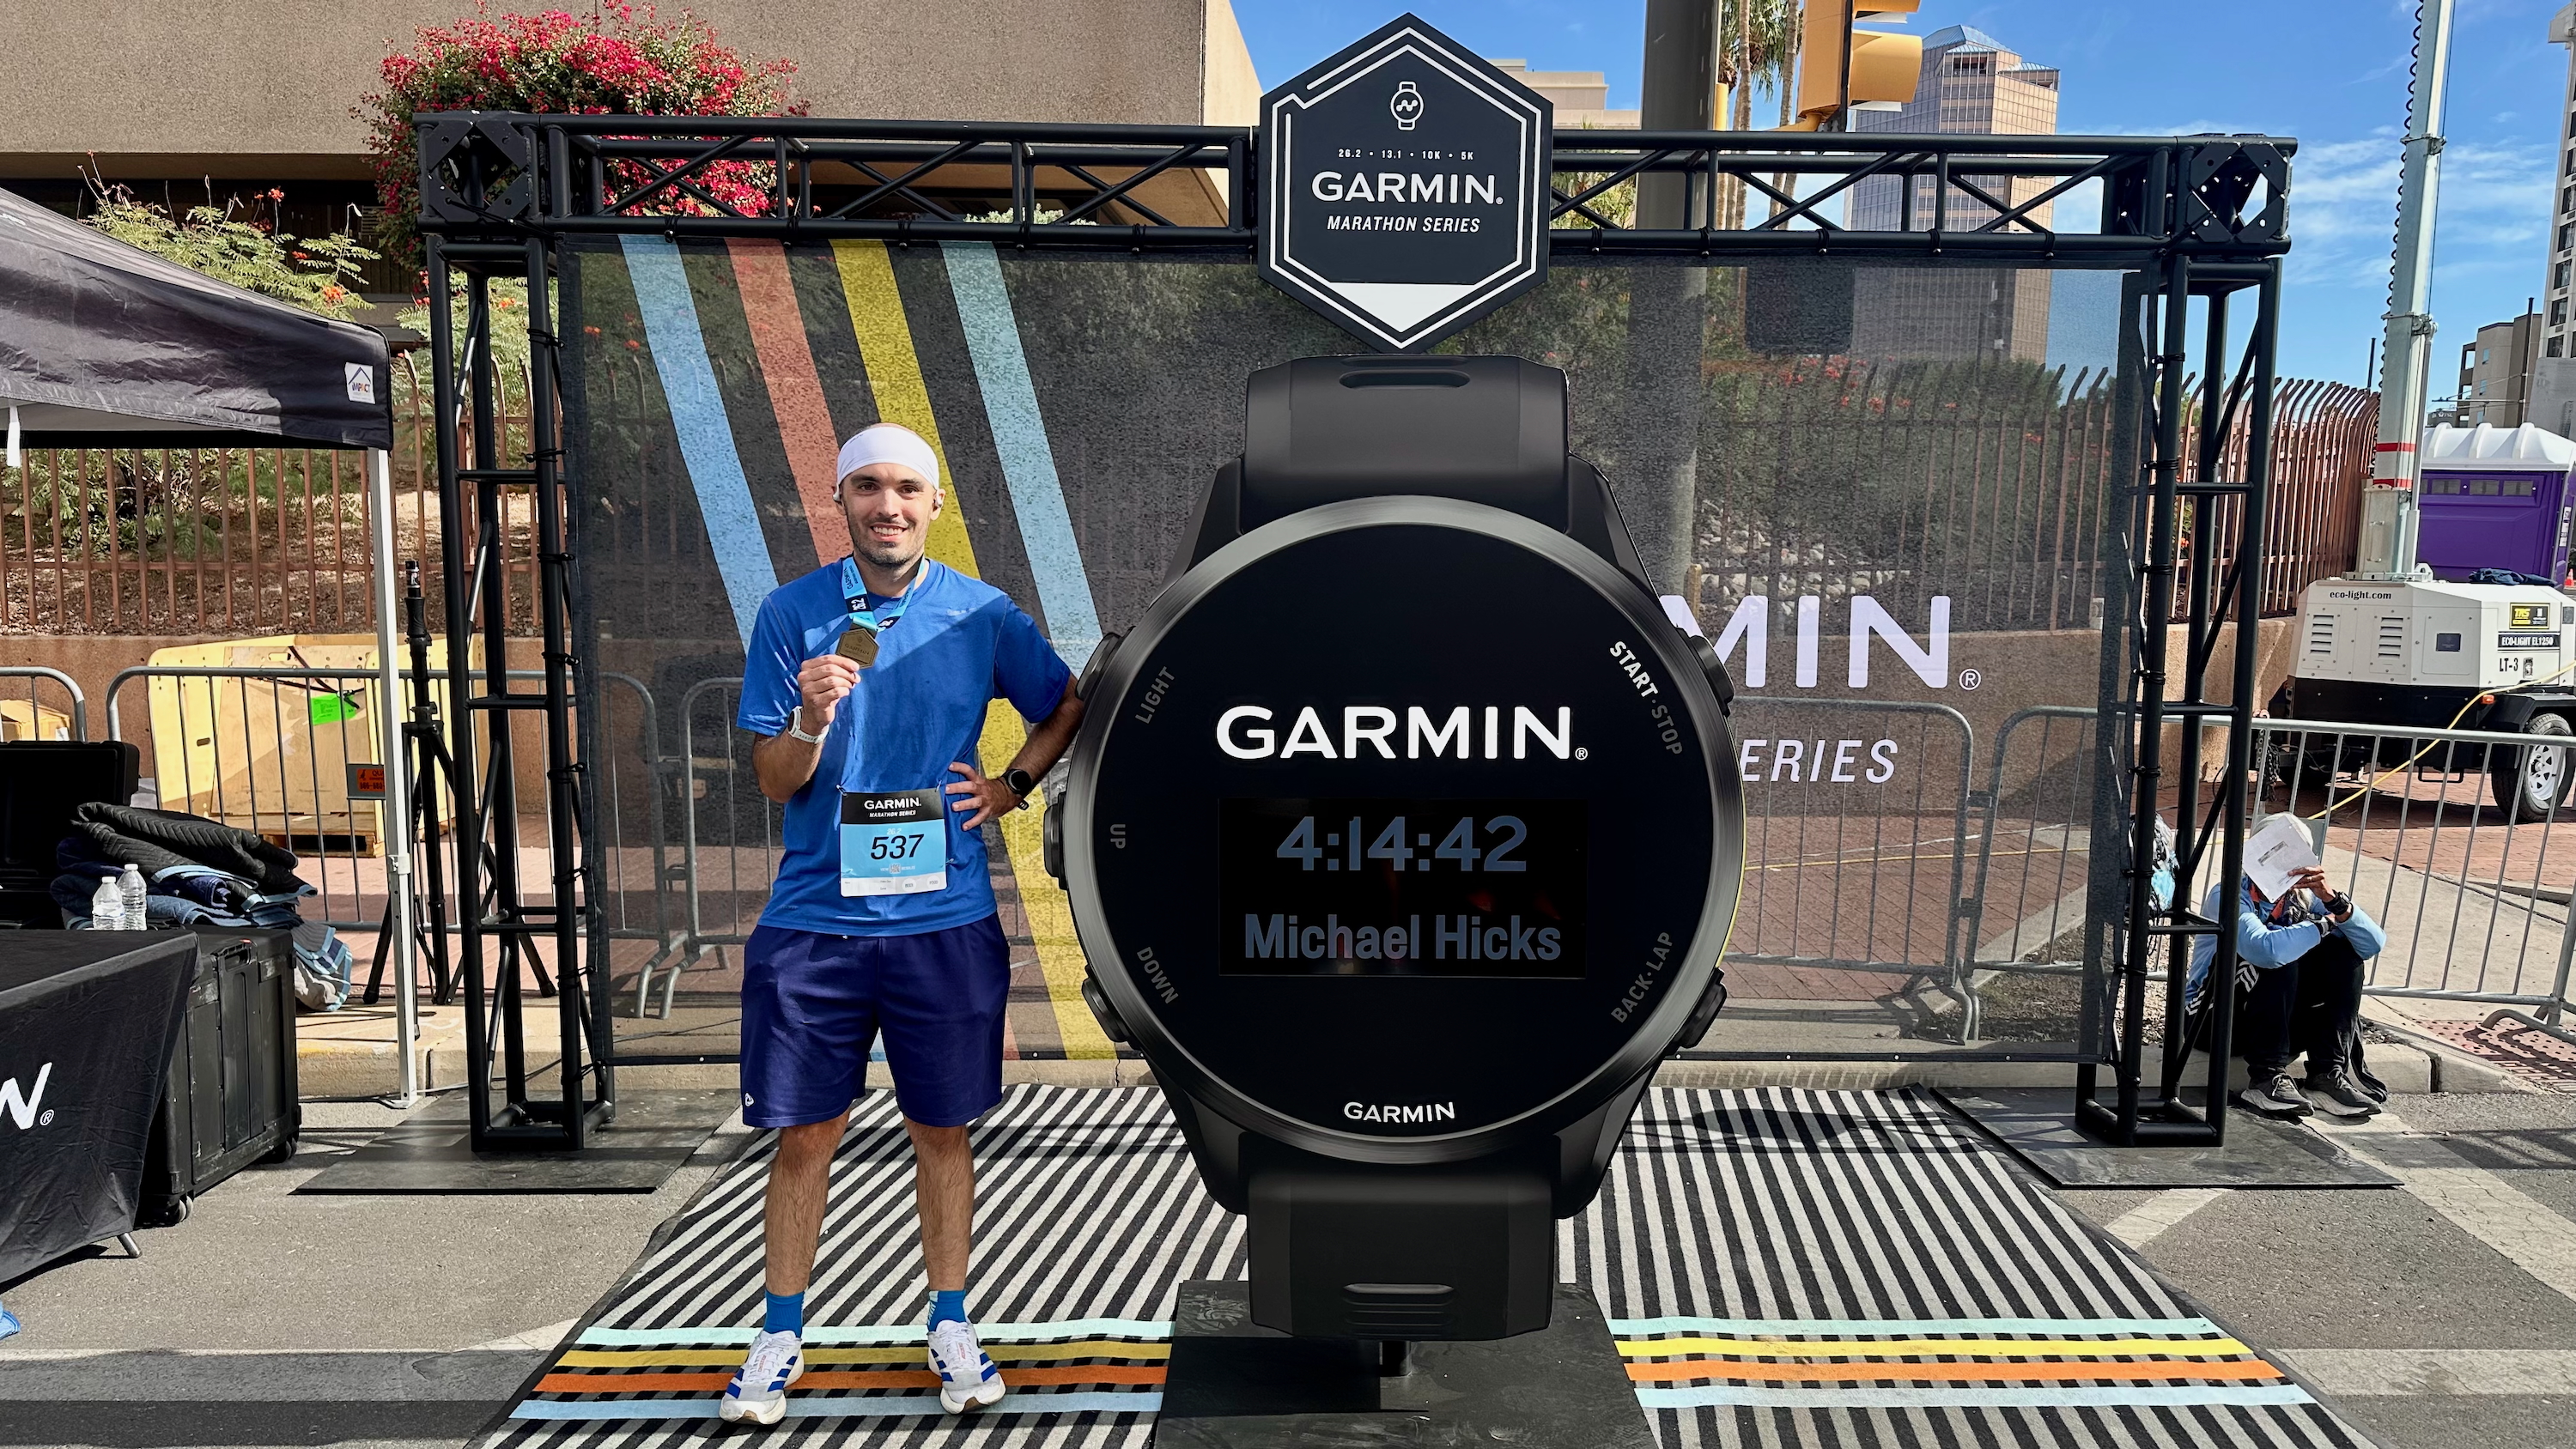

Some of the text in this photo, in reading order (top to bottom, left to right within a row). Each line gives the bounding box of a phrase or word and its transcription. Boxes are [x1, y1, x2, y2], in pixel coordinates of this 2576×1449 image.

[1338, 149, 1474, 161] 26.2 13.1 10K 5K
[1311, 171, 1495, 204] GARMIN
[1327, 215, 1480, 233] MARATHON SERIES
[2330, 590, 2391, 600] eco-light.com
[1659, 595, 1951, 688] MIN
[2532, 636, 2554, 646] EL1250
[2500, 658, 2518, 672] LT-3
[1134, 665, 1176, 724] LIGHT
[1216, 705, 1571, 760] GARMIN
[1740, 739, 1899, 784] ERIES
[864, 797, 919, 810] GARMIN
[871, 834, 925, 860] 537
[1109, 823, 1126, 849] UP
[1276, 815, 1528, 871] 4:14:42
[1245, 913, 1561, 961] Michael Hicks
[1136, 946, 1179, 1004] DOWN
[1343, 1101, 1455, 1124] GARMIN
